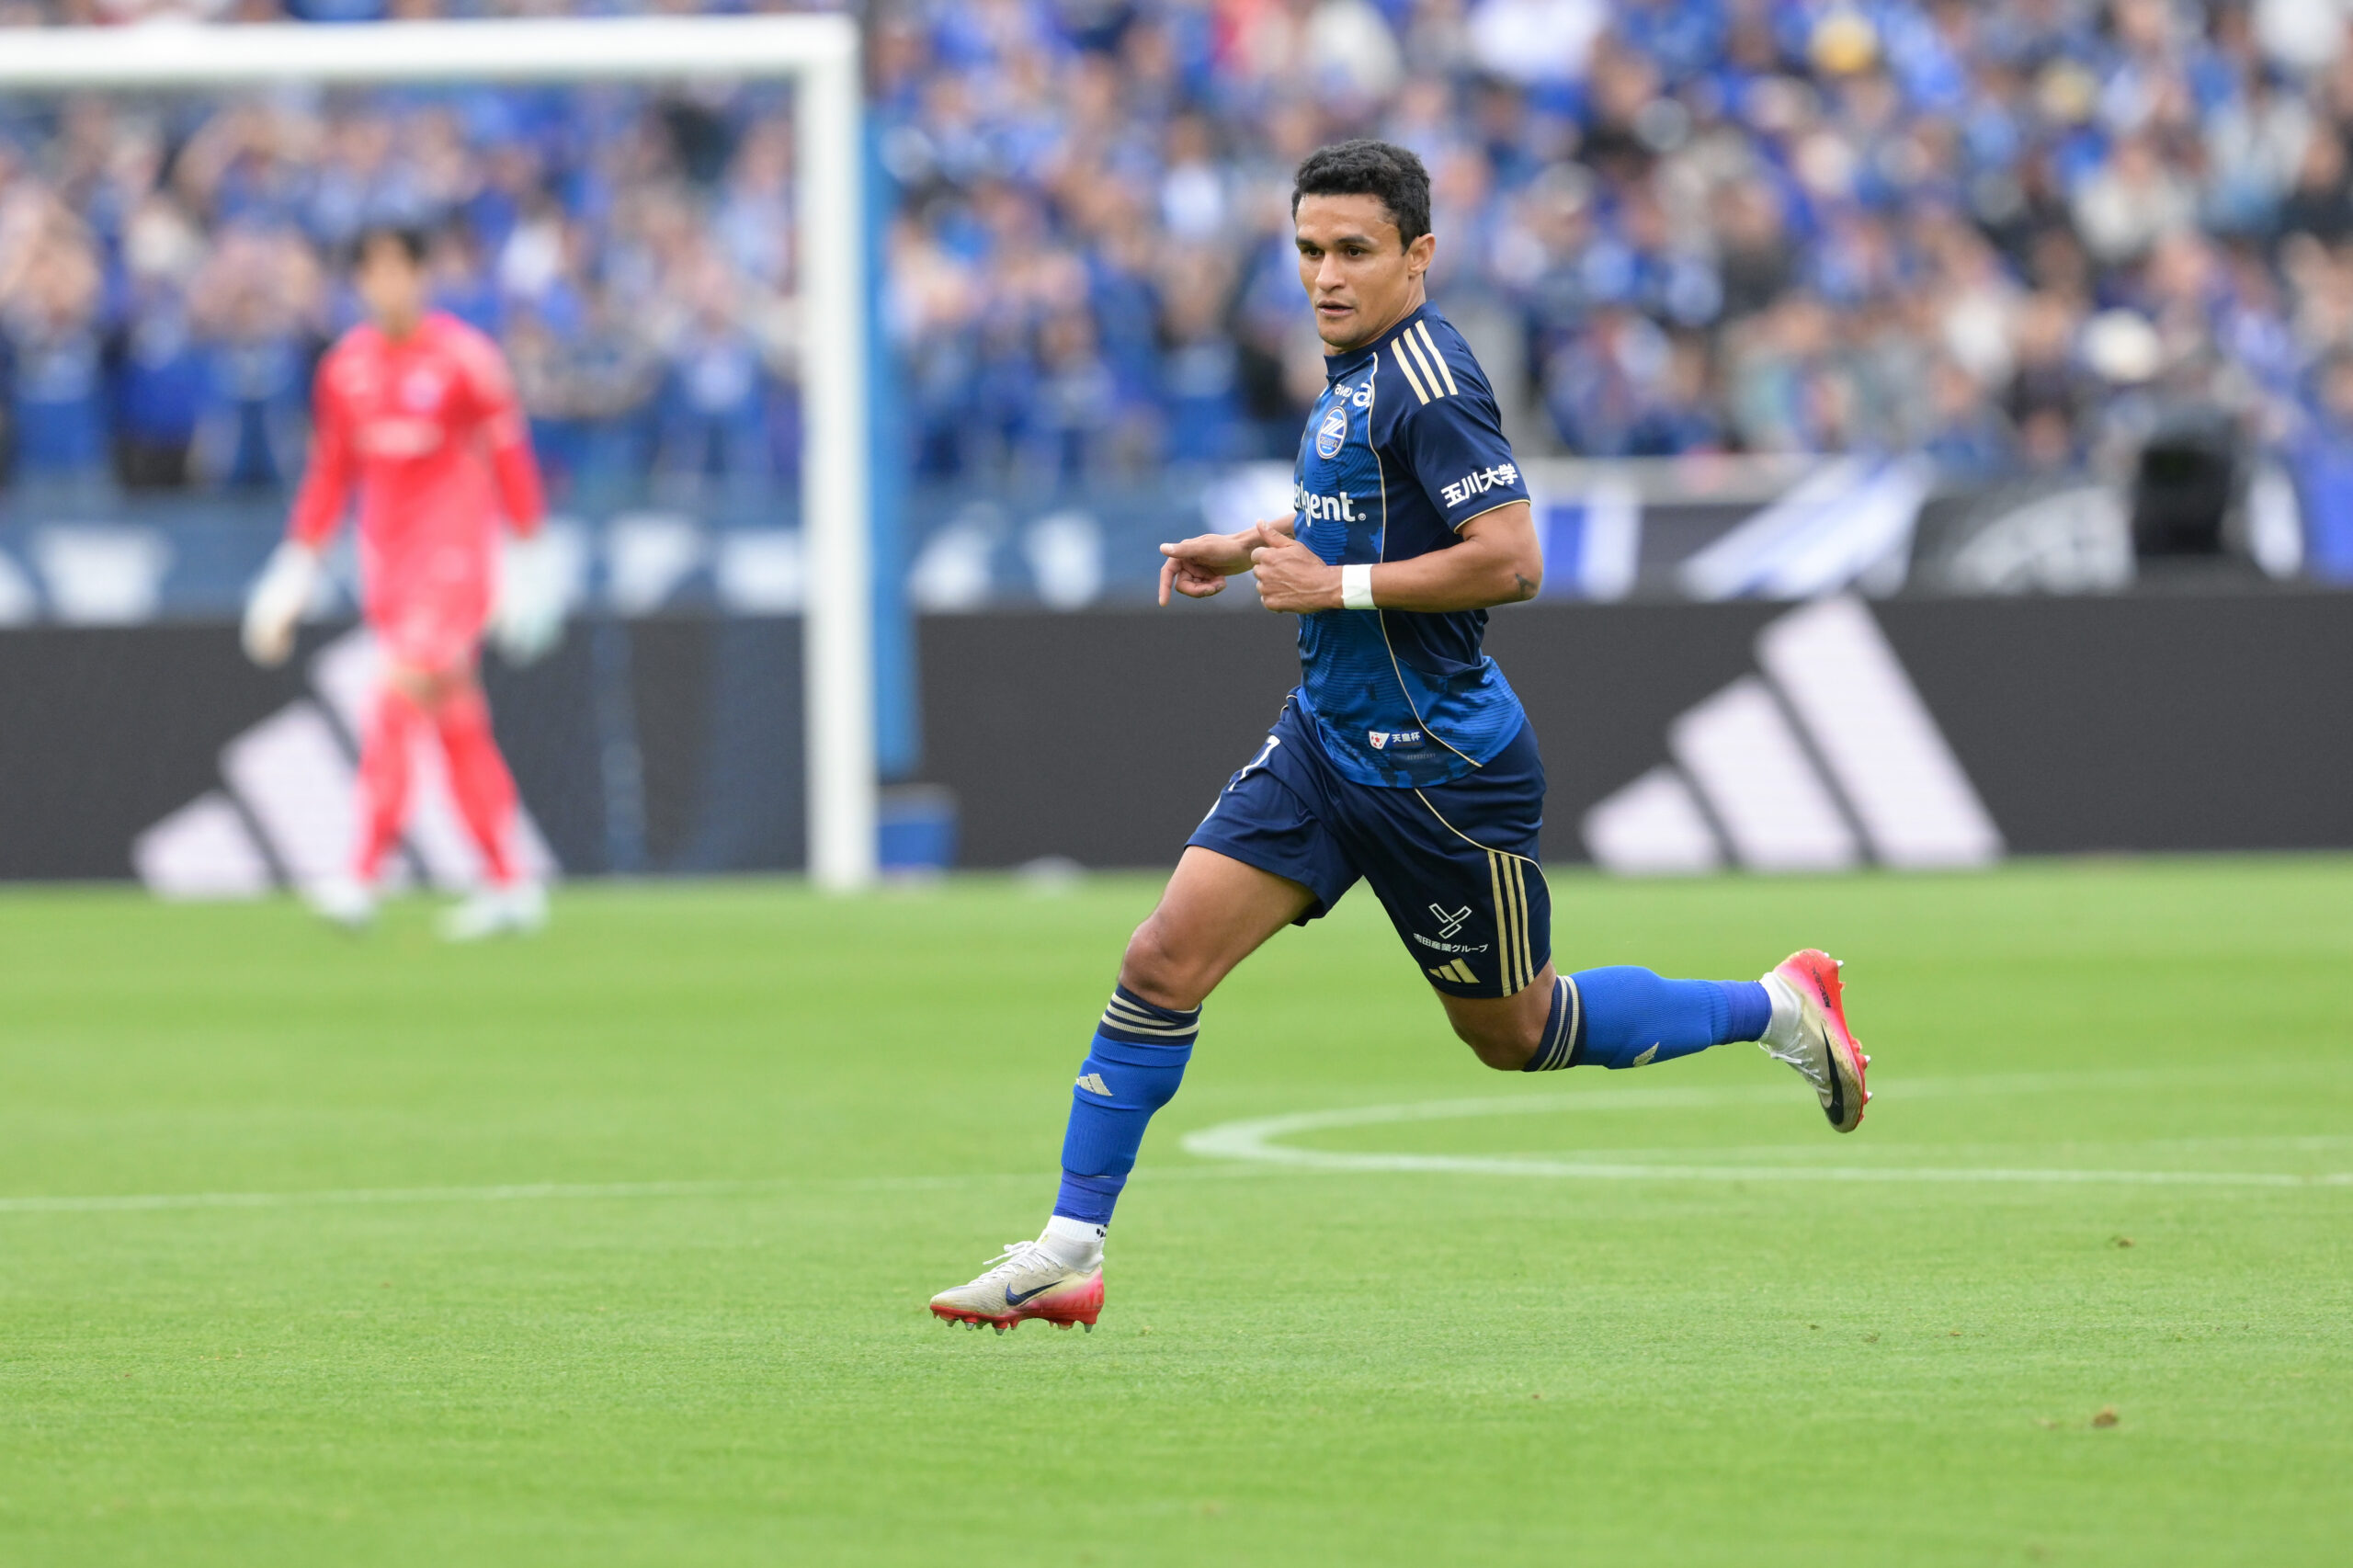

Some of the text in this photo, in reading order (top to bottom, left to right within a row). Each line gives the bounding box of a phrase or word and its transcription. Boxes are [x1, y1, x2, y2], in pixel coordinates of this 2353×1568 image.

[1440, 463, 1518, 508] 玉川大学
[1392, 732, 1421, 743] 天皇杯
